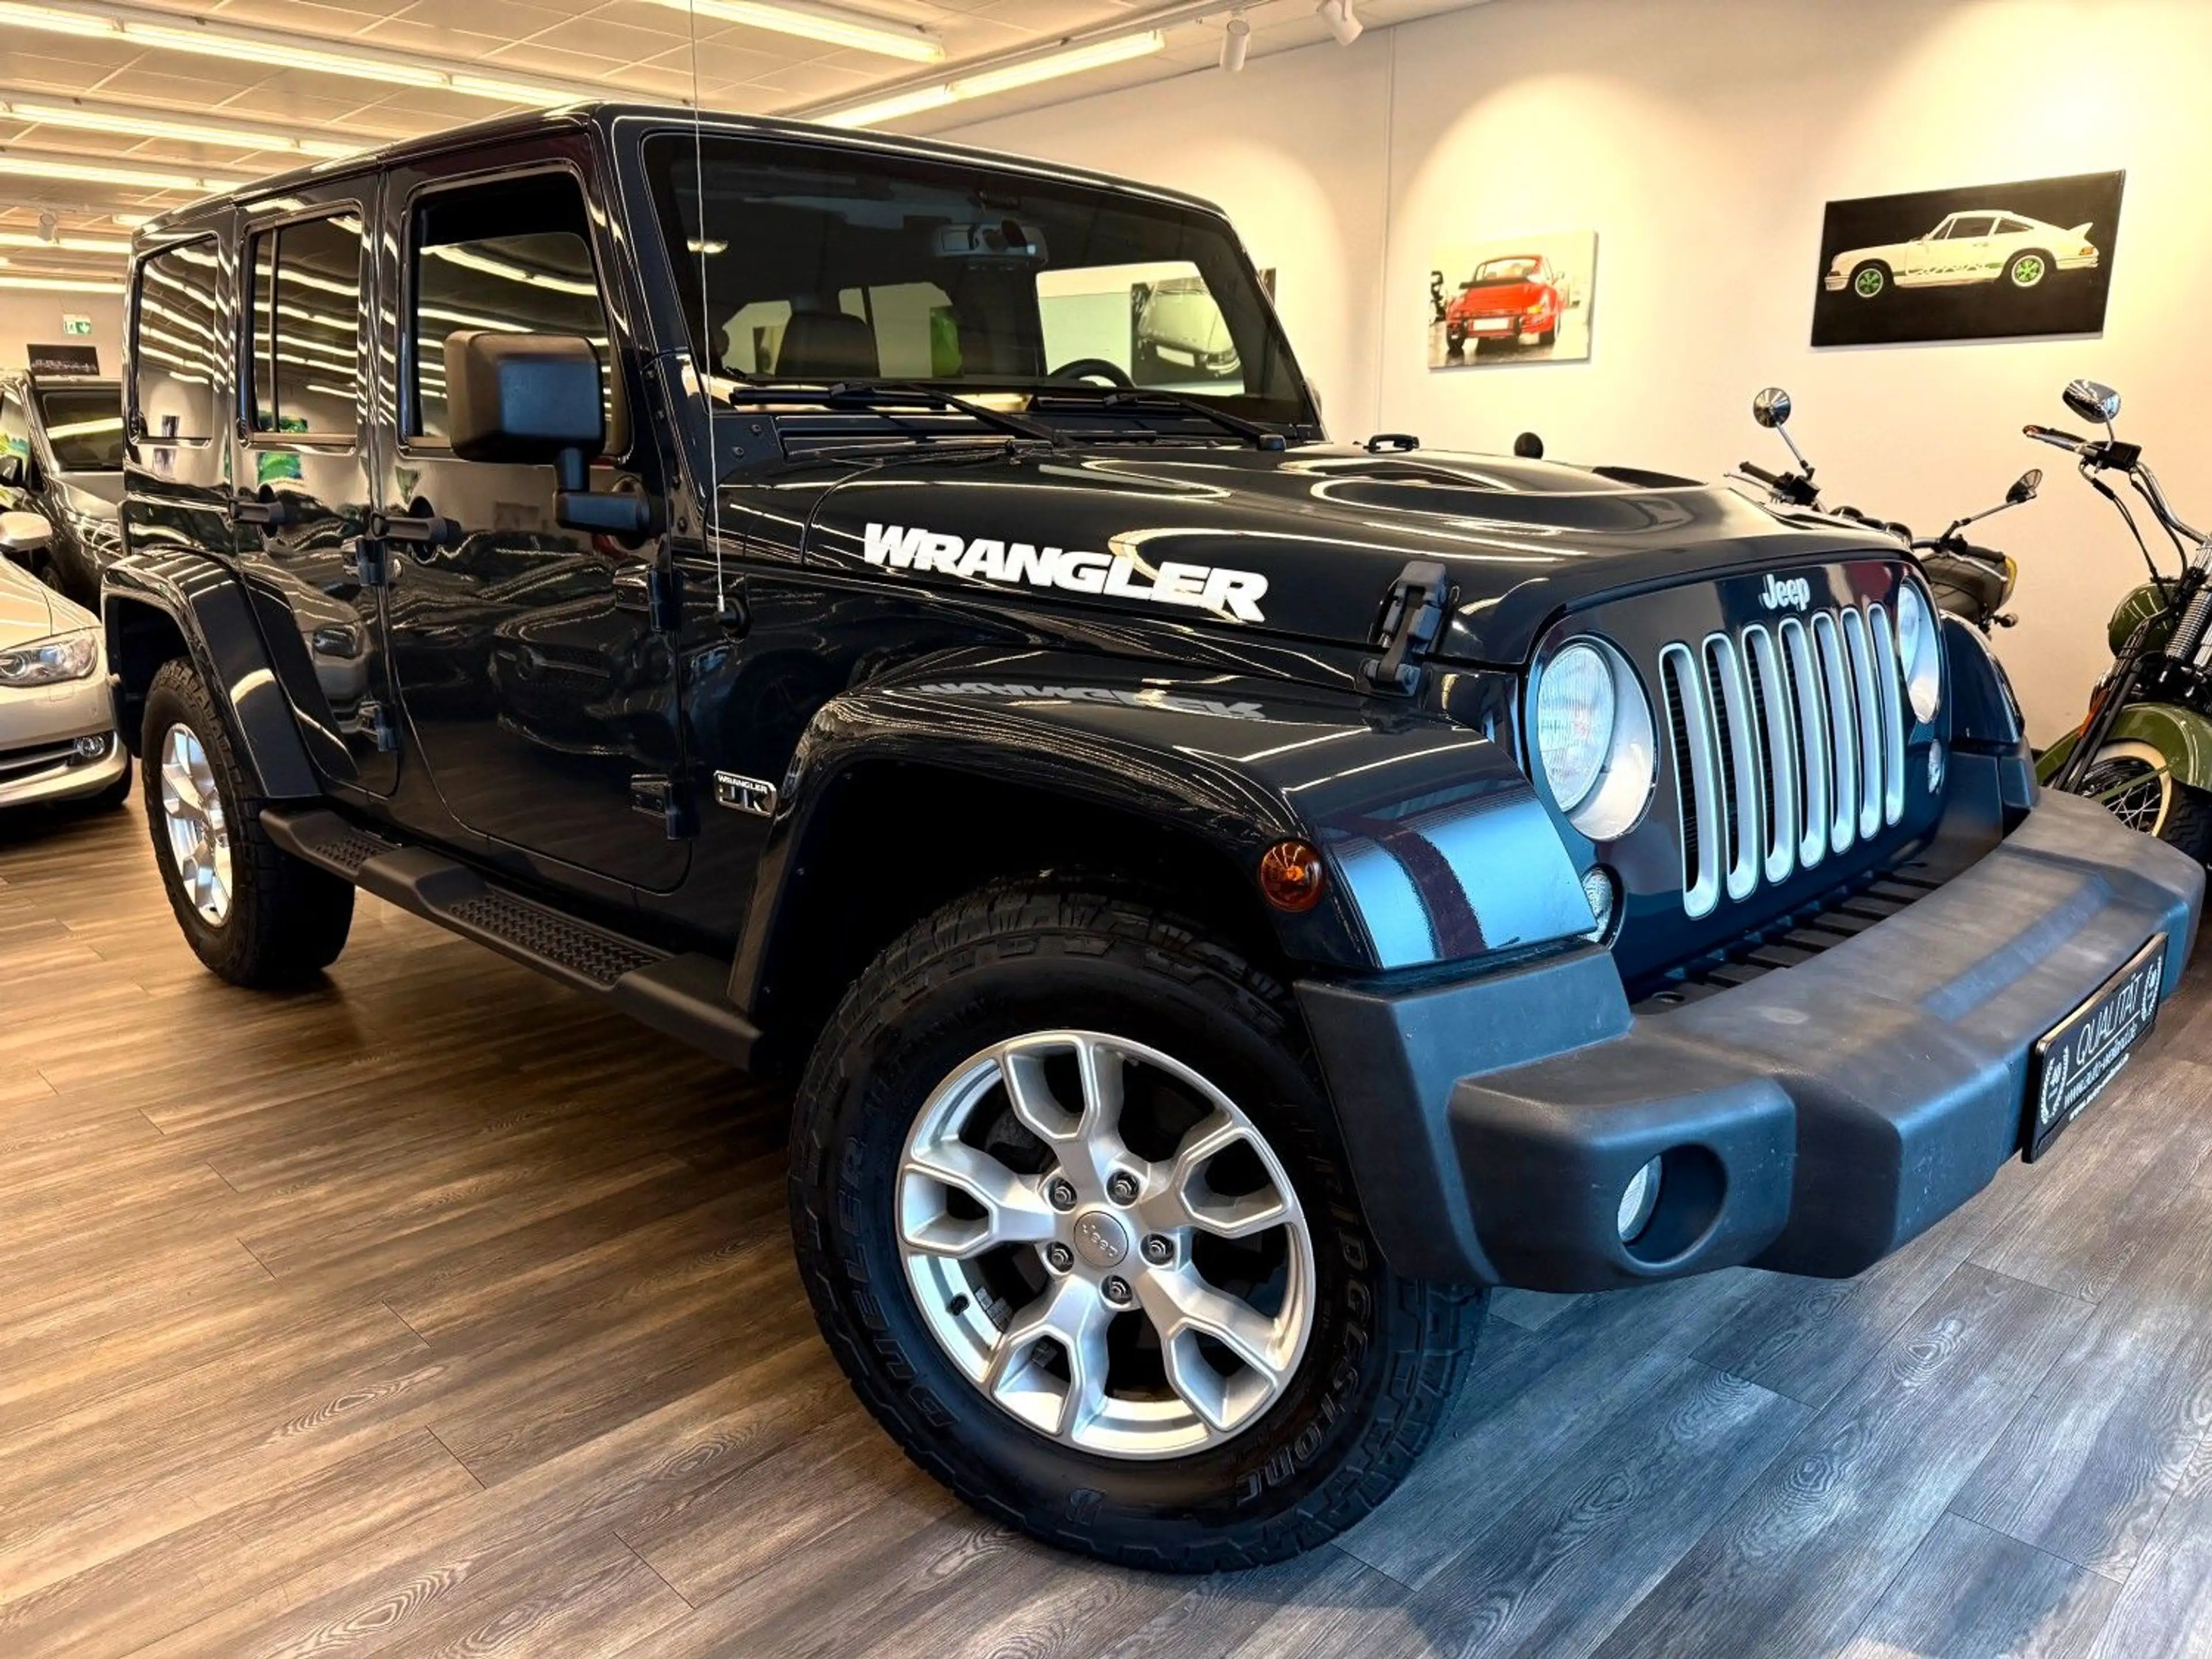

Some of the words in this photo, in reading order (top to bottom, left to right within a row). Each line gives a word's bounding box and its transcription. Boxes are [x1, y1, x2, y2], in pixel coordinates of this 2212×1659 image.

[865, 522, 1268, 623] WRANGLER
[1759, 574, 1810, 611] Jeep
[2076, 972, 2143, 1066] QUALITÄT
